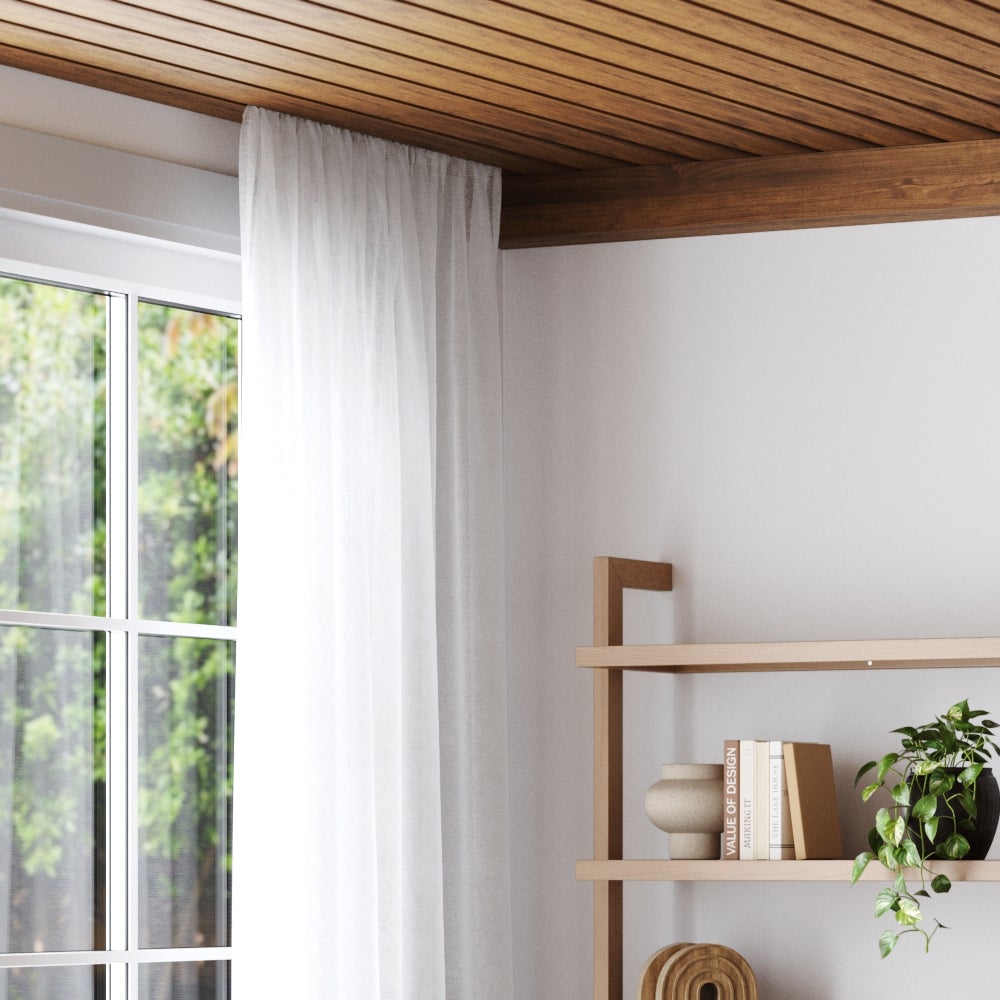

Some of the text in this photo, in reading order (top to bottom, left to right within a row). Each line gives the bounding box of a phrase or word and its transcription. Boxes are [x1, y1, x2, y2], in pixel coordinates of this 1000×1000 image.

[726, 747, 737, 856] VALUE OF DESIGN
[743, 798, 752, 849] MAKING IT
